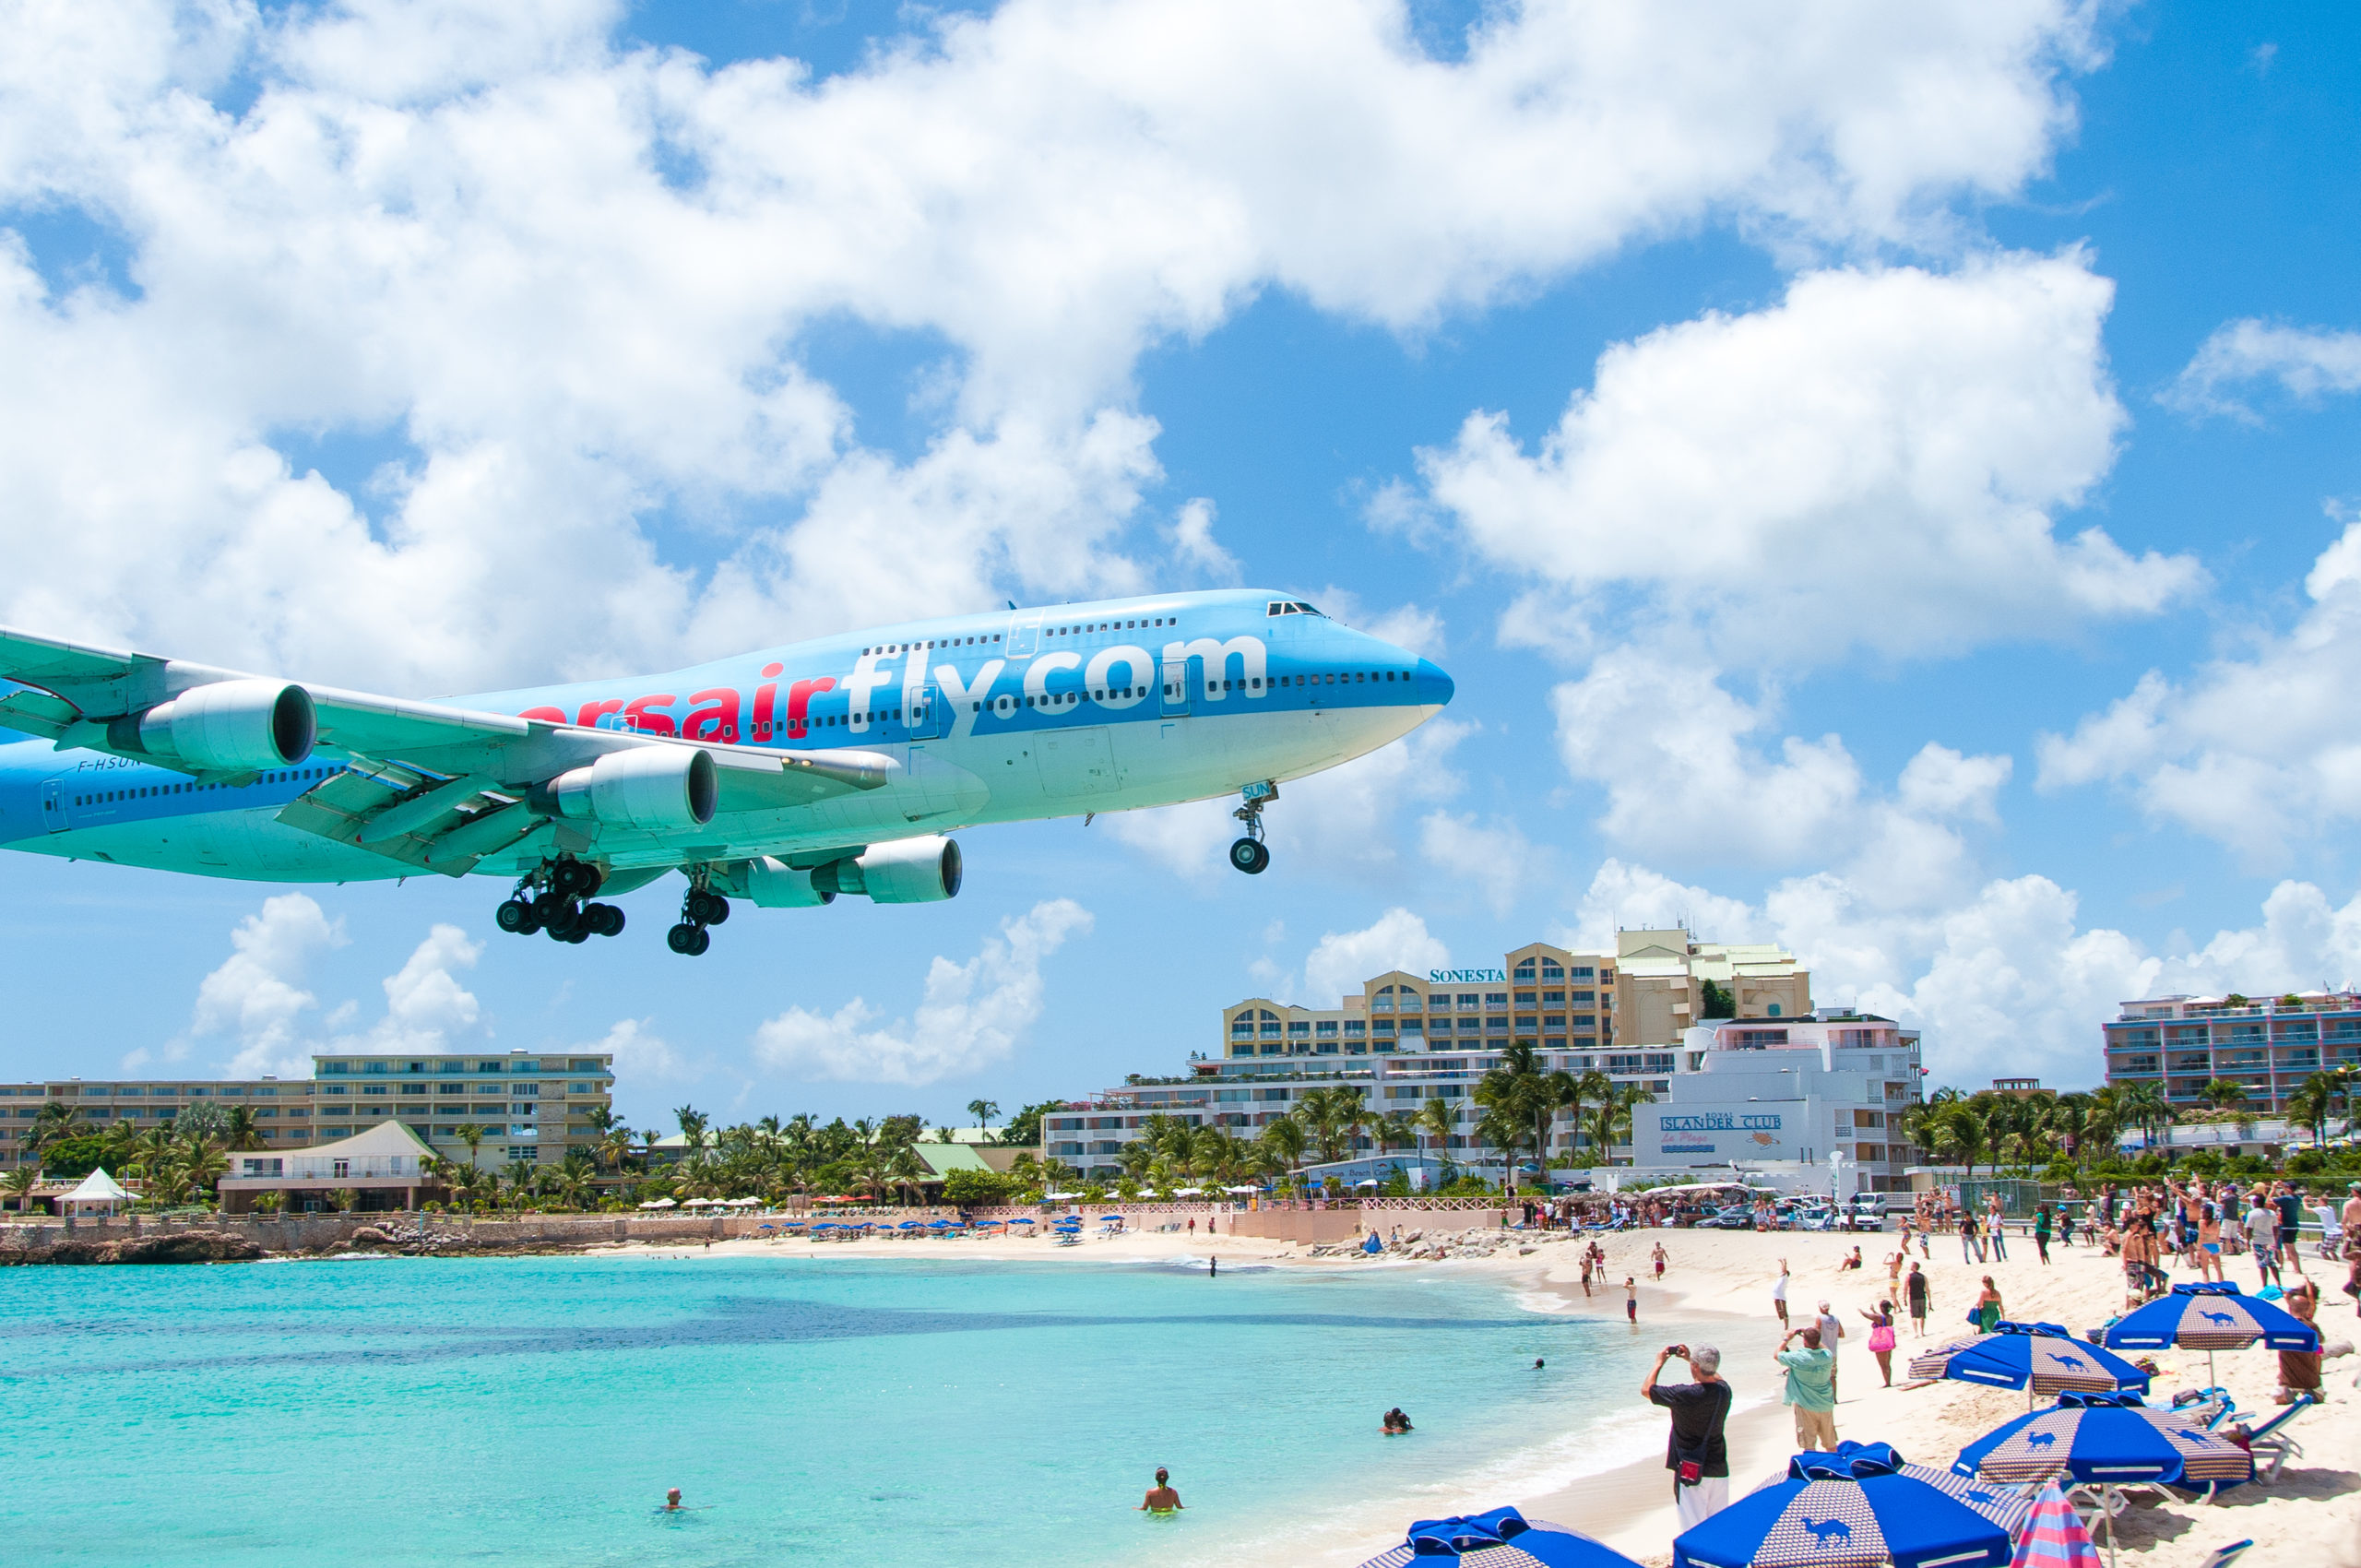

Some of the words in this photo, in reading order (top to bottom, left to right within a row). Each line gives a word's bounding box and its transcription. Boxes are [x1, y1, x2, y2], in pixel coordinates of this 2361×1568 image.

[1242, 782, 1270, 800] SUN
[1660, 1117, 1735, 1129] ISLANDER
[1743, 1117, 1781, 1128] CLUB
